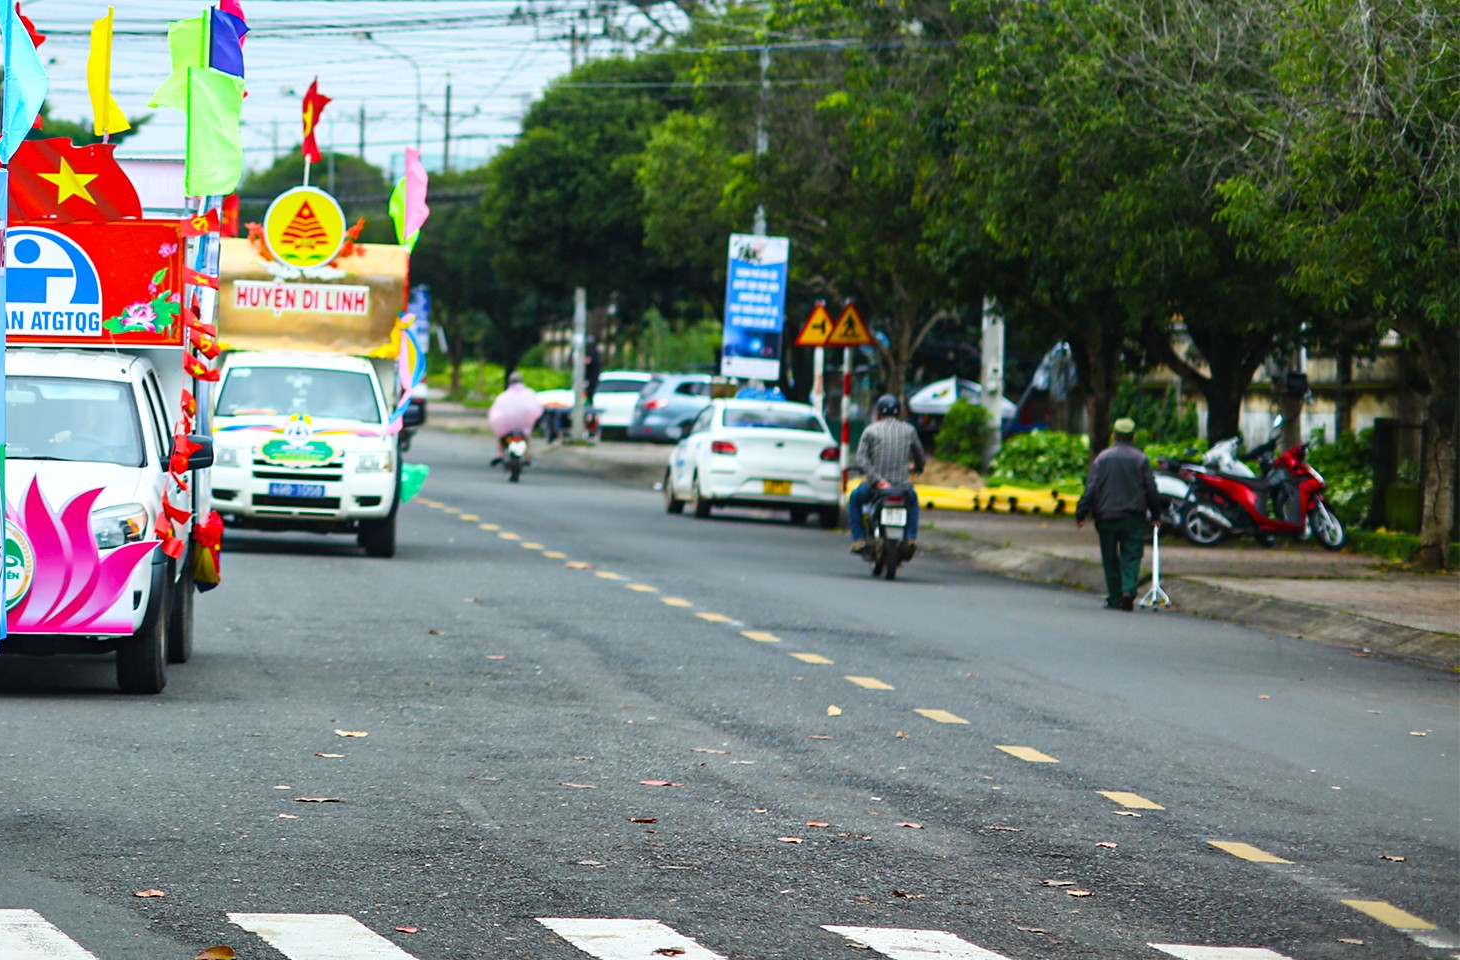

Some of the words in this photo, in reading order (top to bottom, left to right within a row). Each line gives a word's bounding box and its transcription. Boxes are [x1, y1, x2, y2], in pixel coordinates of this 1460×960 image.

[236, 282, 296, 314] HUYỆN
[302, 290, 318, 310] DI
[325, 291, 366, 312] LINH
[31, 311, 100, 333] ATGTQG
